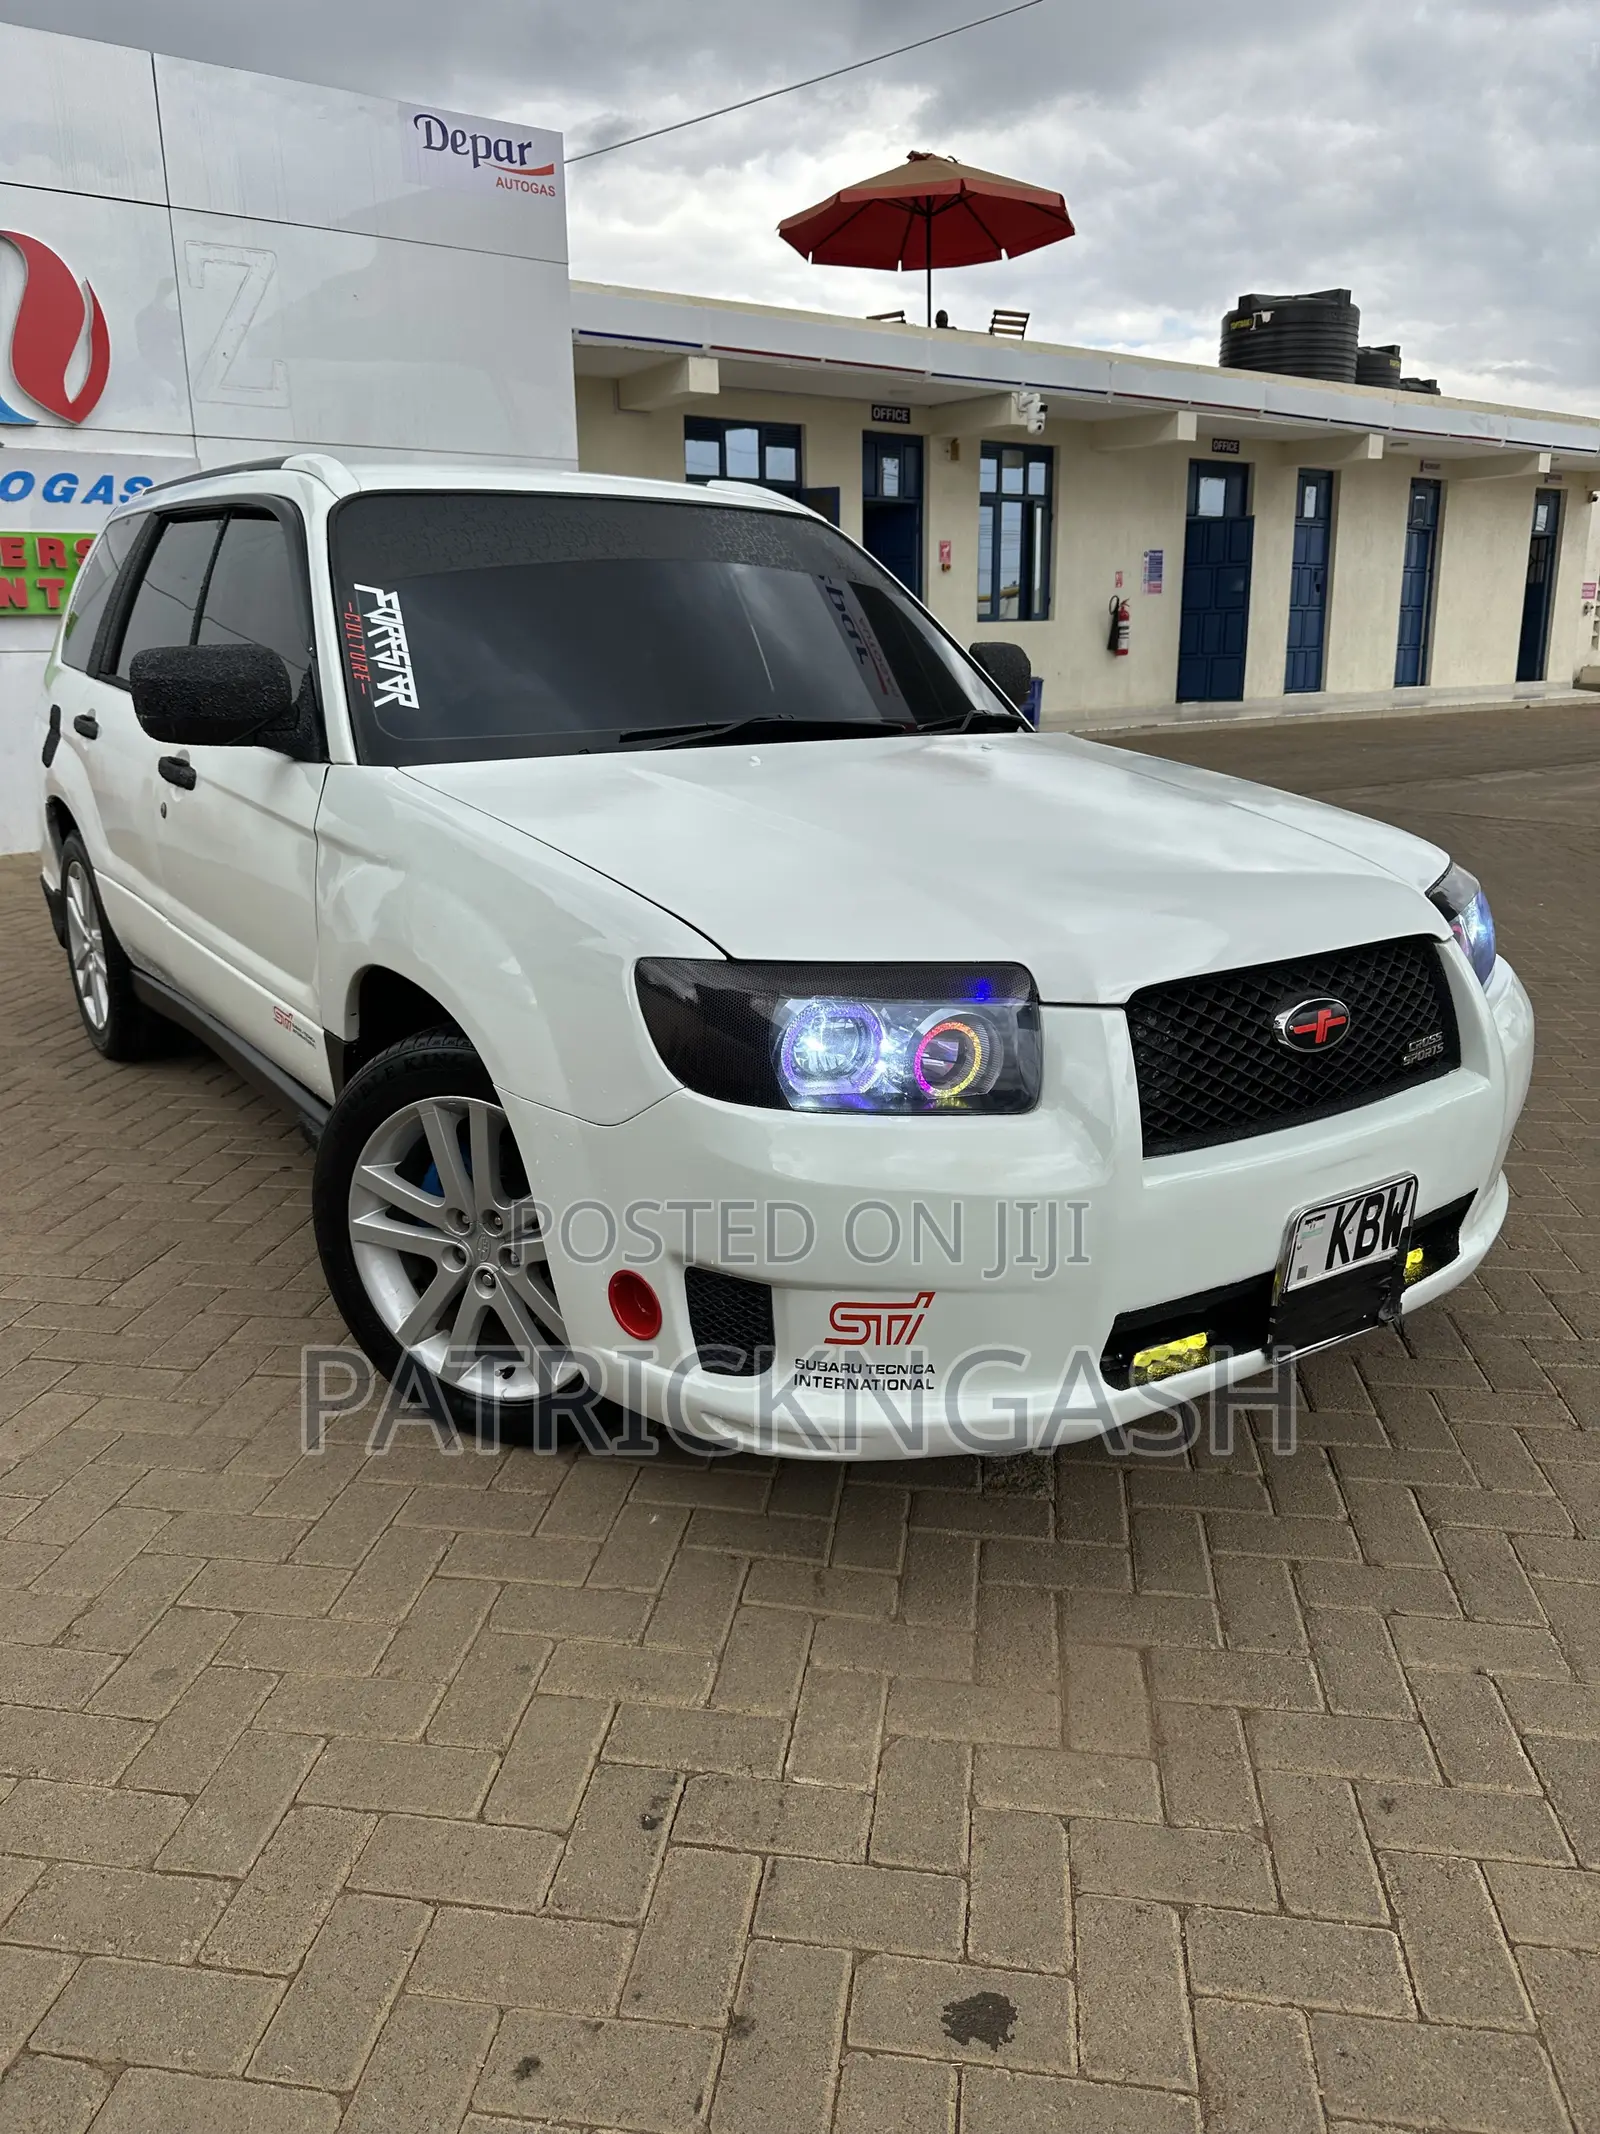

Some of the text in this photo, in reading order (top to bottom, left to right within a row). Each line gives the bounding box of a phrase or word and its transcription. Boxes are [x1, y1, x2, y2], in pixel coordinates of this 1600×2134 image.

[413, 113, 532, 169] Depar
[496, 176, 556, 197] AUTOGAS
[873, 407, 909, 422] OFFICE
[1213, 440, 1239, 452] OFFICE
[1408, 1031, 1443, 1051] CROSS
[1402, 1042, 1444, 1067] SPORTS
[1324, 1180, 1415, 1271] KBW
[794, 1358, 936, 1375] SUBARU TECNICA
[793, 1374, 935, 1391] INTERNATIONAL
